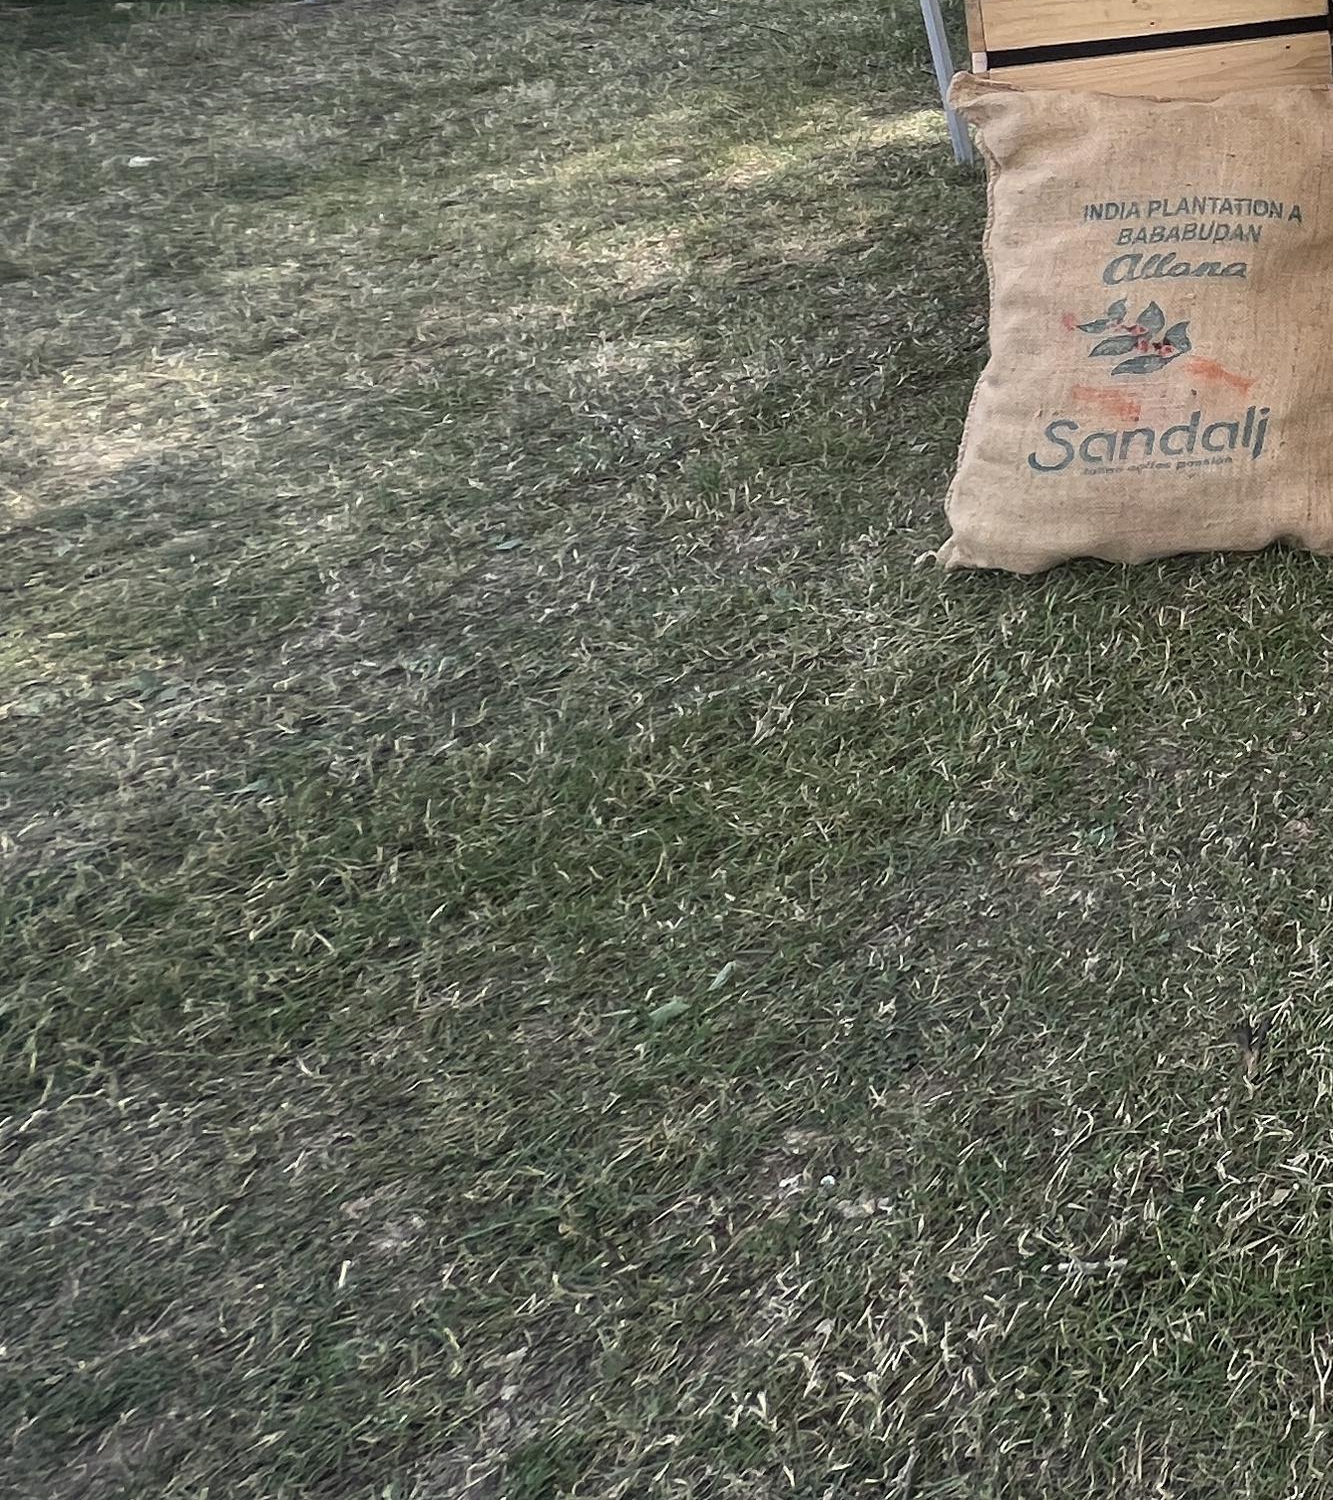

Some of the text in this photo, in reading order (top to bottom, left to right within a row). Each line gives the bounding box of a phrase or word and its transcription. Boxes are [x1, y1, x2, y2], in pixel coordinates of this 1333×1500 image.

[1083, 196, 1302, 223] INDIA PLANTATION A
[1115, 221, 1263, 246] BABABUDAN
[1028, 405, 1271, 472] Sandalj
